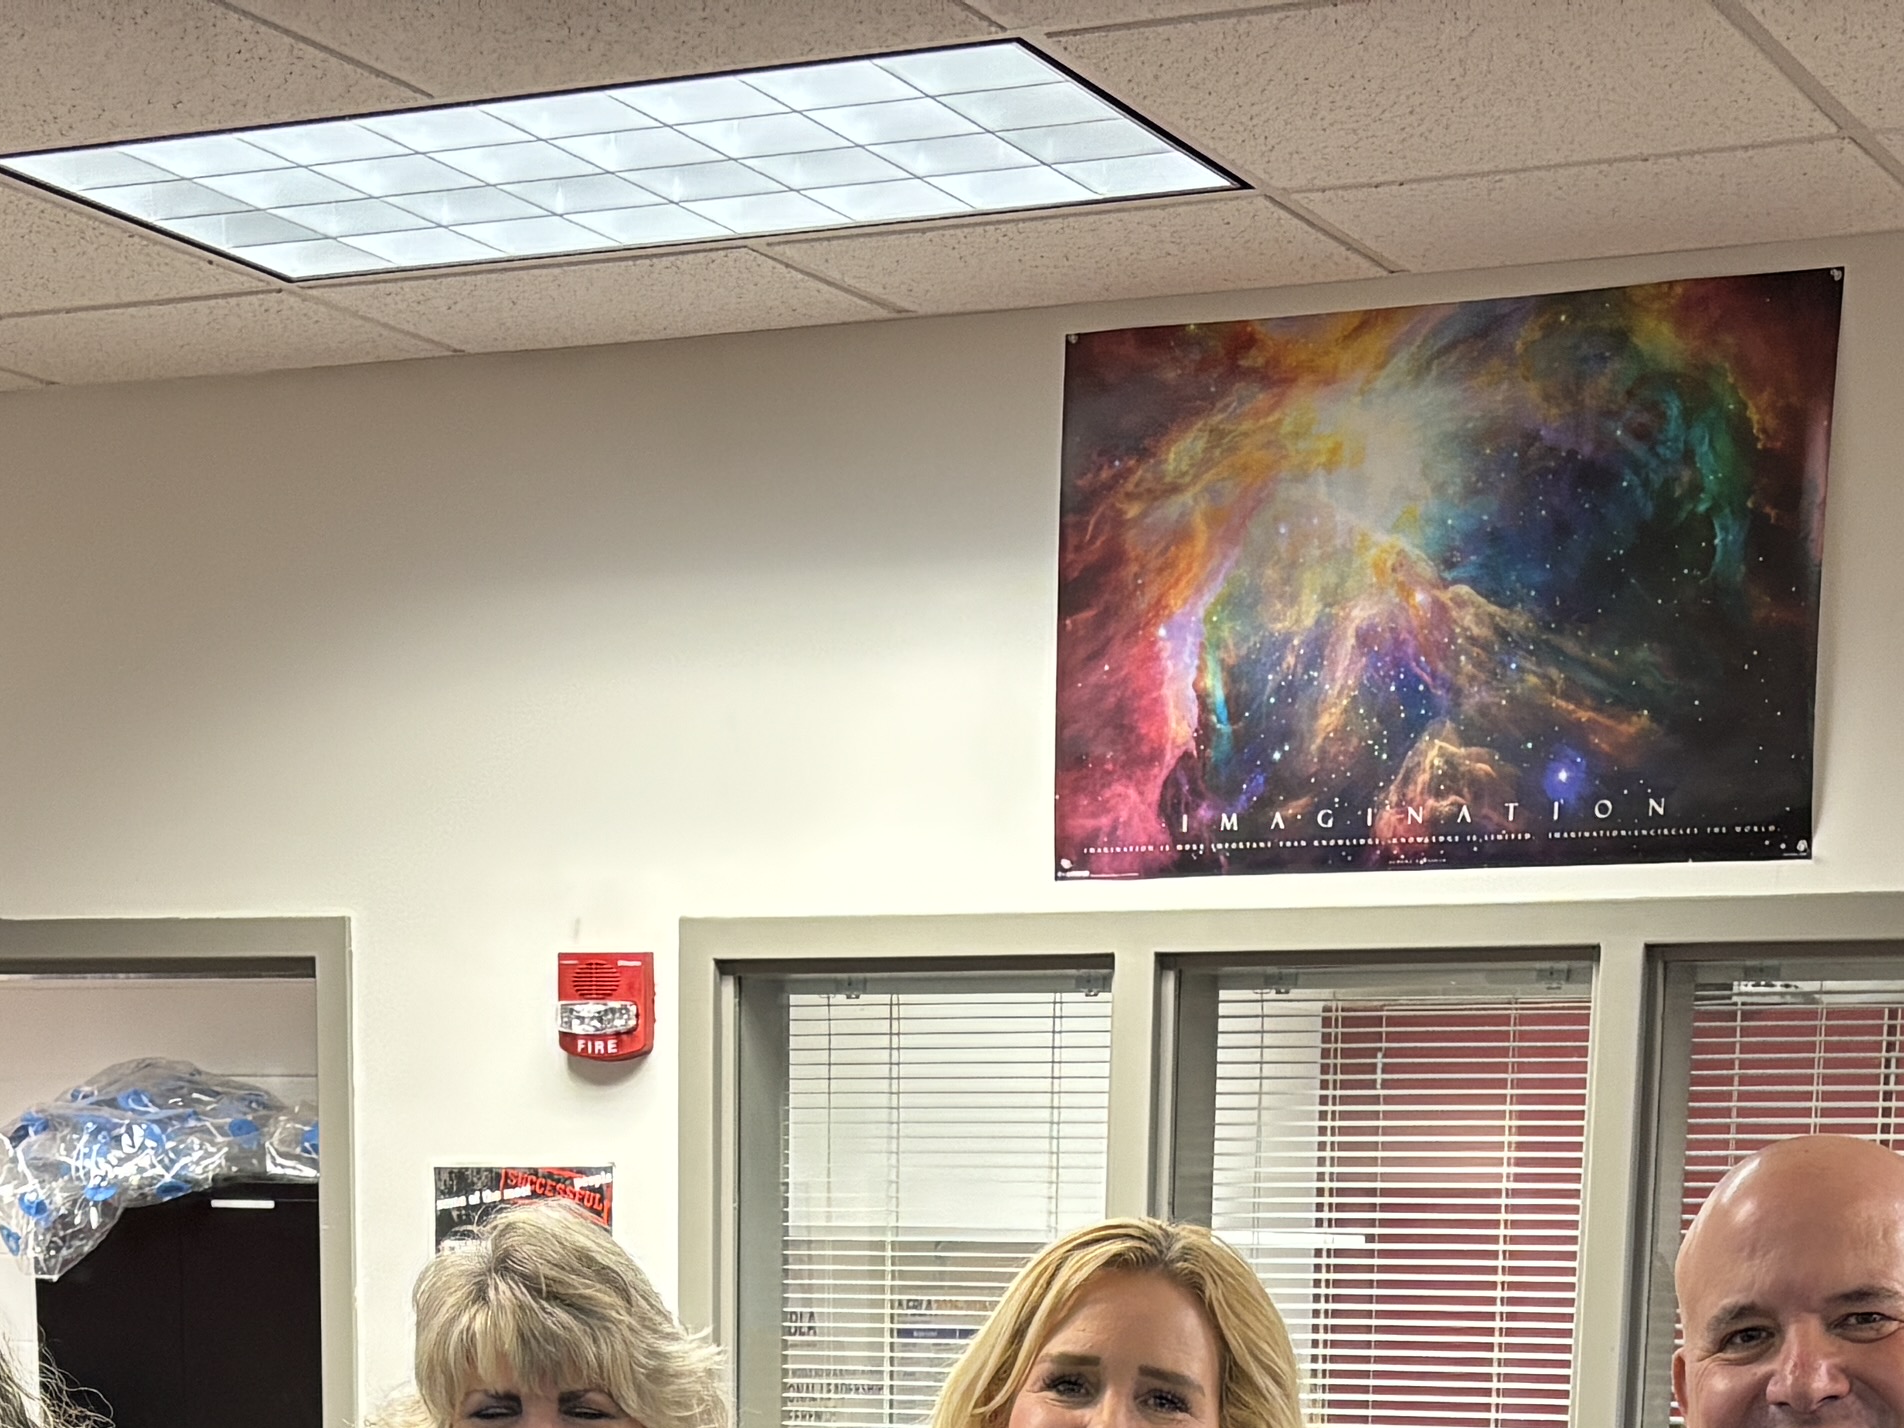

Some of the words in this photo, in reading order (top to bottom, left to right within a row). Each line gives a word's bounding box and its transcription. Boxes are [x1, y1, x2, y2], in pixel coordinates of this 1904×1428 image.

[1180, 797, 1666, 833] IMAGINATION
[576, 1038, 618, 1055] FIRE
[506, 1170, 604, 1211] SUCCESSFUL
